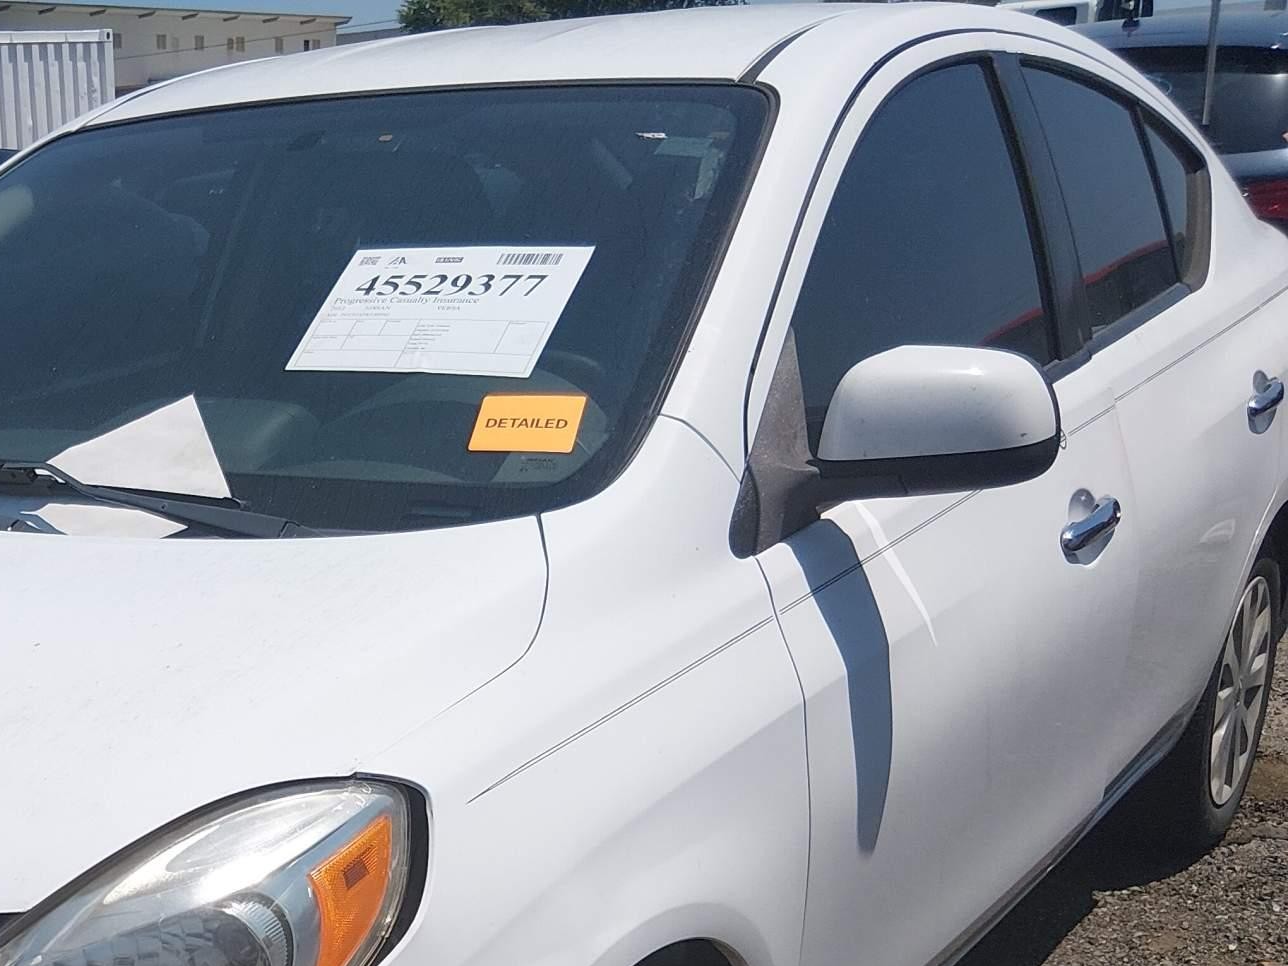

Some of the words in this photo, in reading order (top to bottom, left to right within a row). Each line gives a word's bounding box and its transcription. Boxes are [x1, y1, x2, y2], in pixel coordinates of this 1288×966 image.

[354, 274, 550, 297] 45529377
[333, 297, 388, 306] Progressive
[390, 297, 429, 305] Casualty
[484, 417, 569, 430] DETAILED
